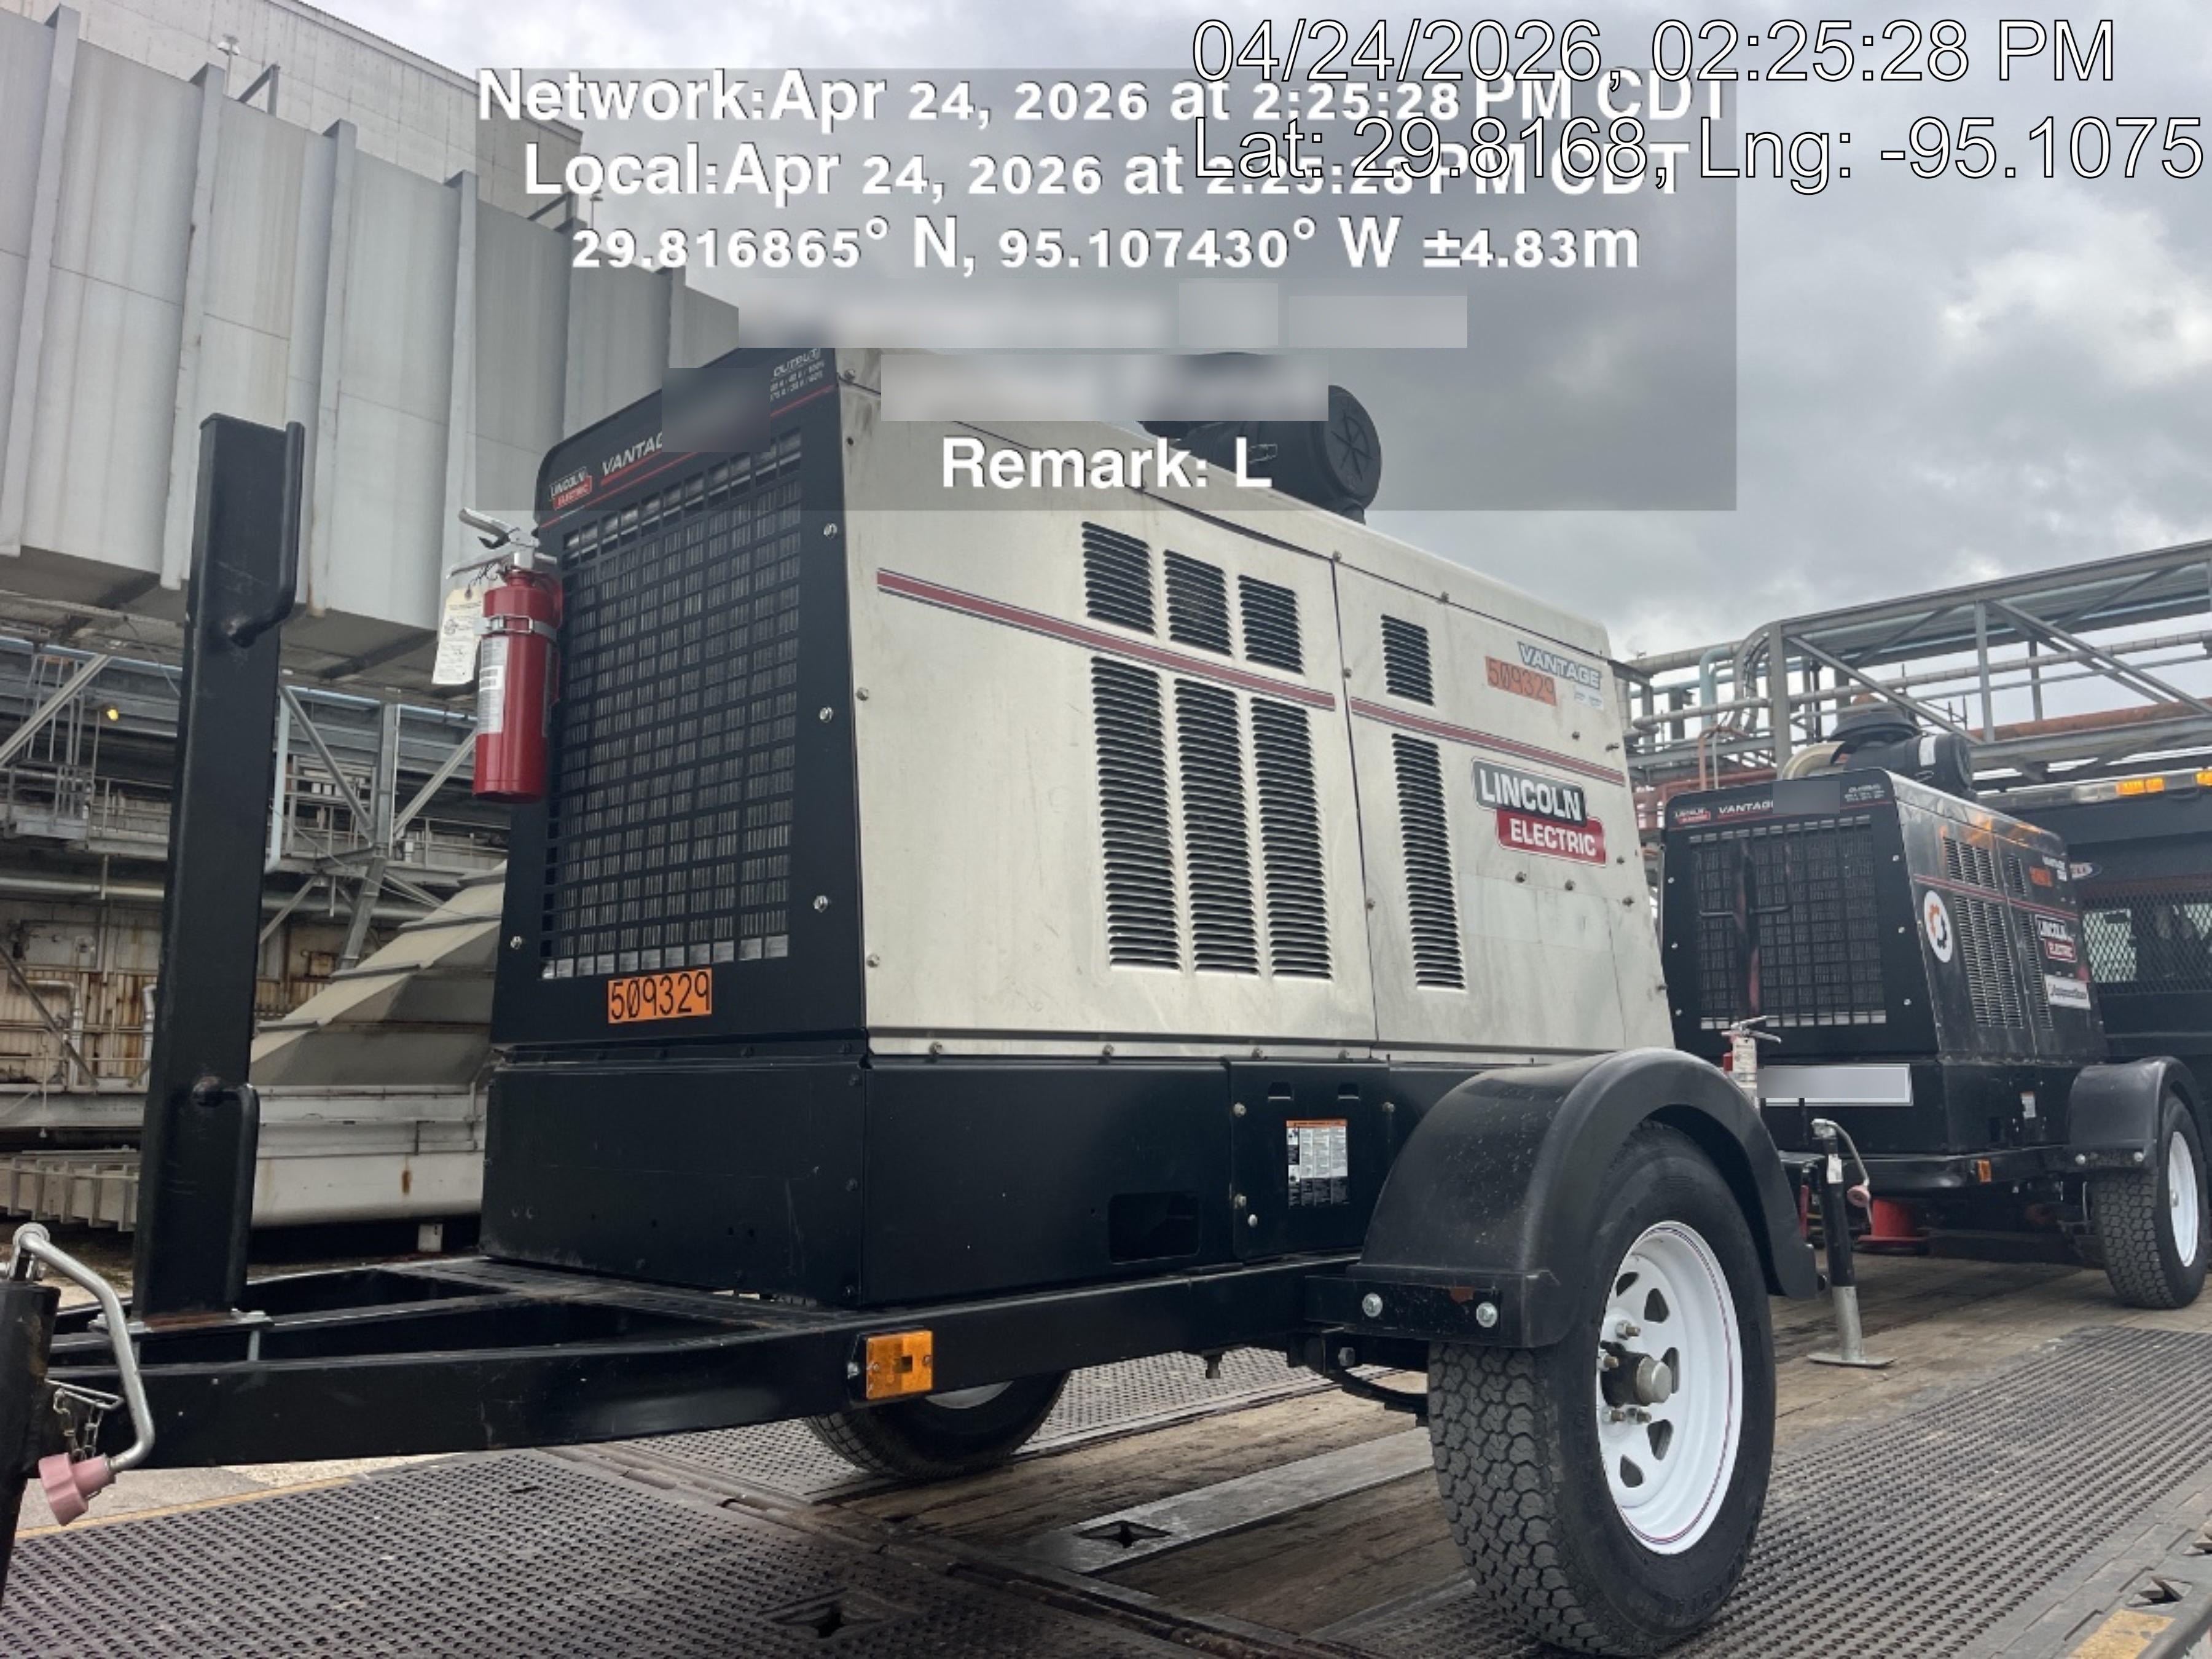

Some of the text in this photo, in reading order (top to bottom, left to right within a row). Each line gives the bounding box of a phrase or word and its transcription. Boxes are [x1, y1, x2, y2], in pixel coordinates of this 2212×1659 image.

[602, 432, 662, 477] VANTAG
[1488, 659, 1555, 702] 509329
[1517, 641, 1602, 690] VANTAGE
[1479, 768, 1582, 822] LINCOLN
[1510, 818, 1596, 857] ELECTRIC
[611, 971, 710, 1020] 509329
